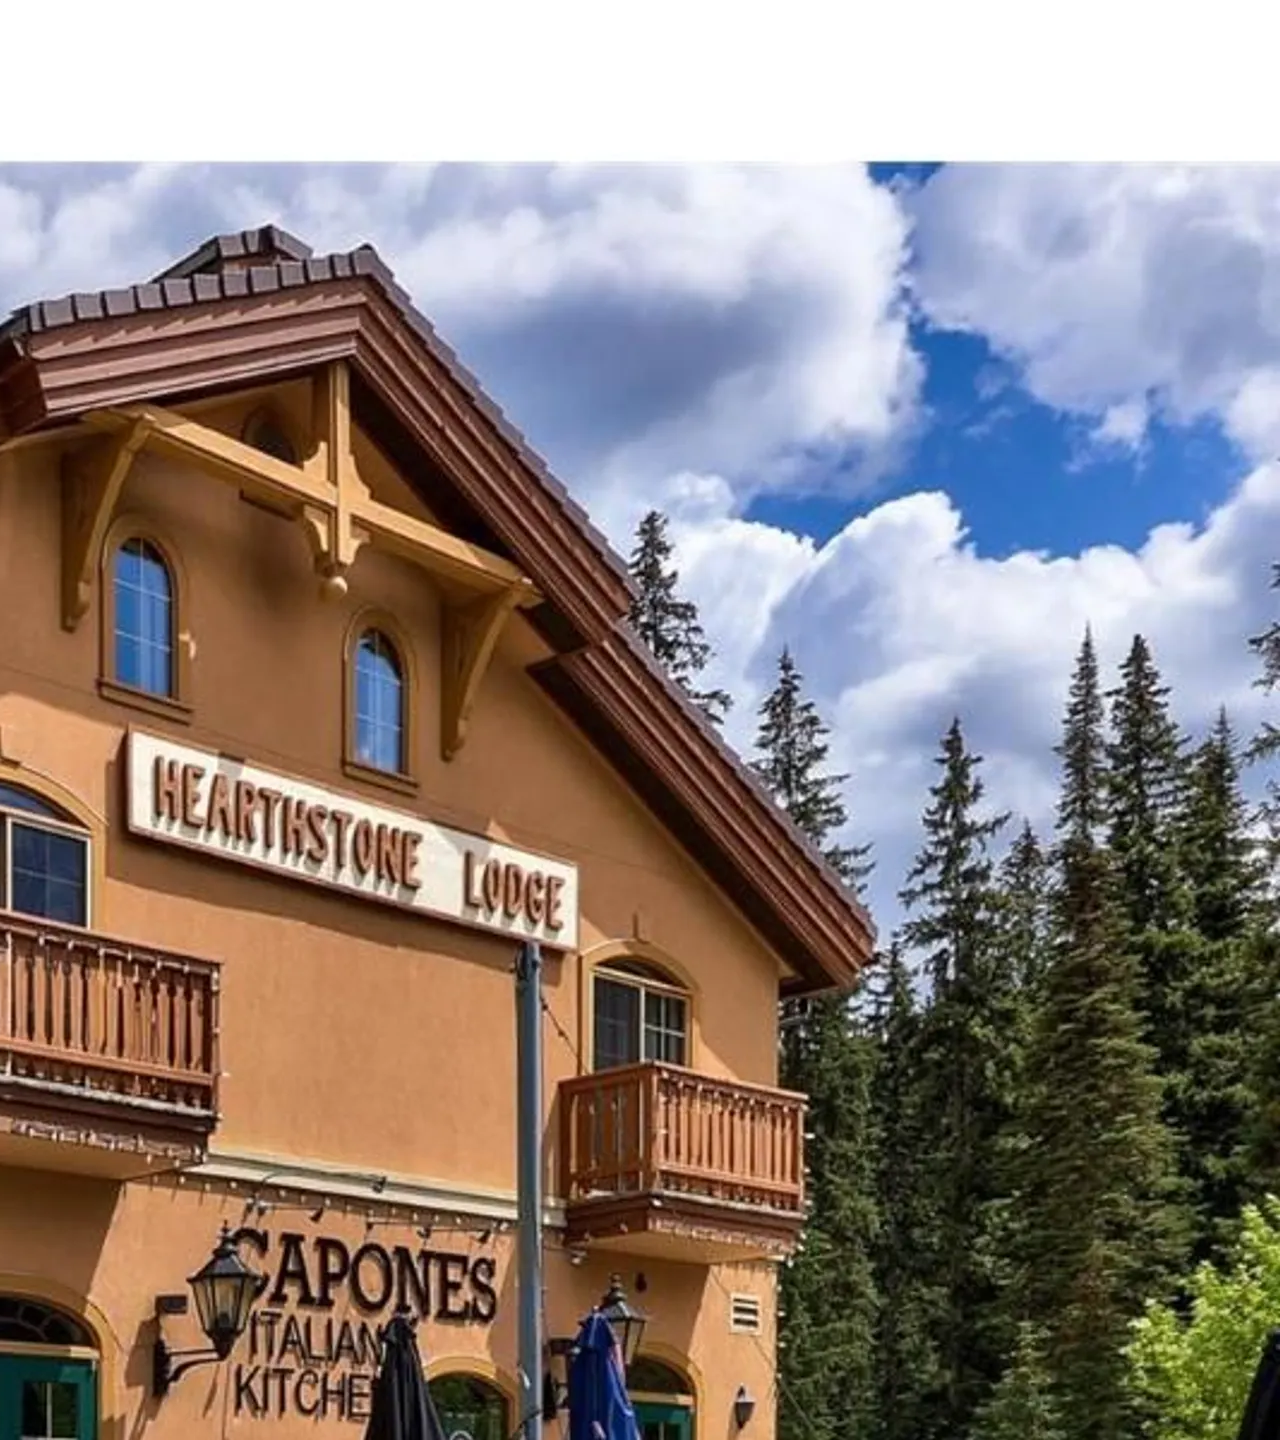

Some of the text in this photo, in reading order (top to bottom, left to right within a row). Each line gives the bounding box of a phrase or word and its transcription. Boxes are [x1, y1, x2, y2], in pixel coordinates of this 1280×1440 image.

[153, 754, 565, 932] HEARTHSTONE LODGE
[234, 1363, 380, 1421] KITCHE
